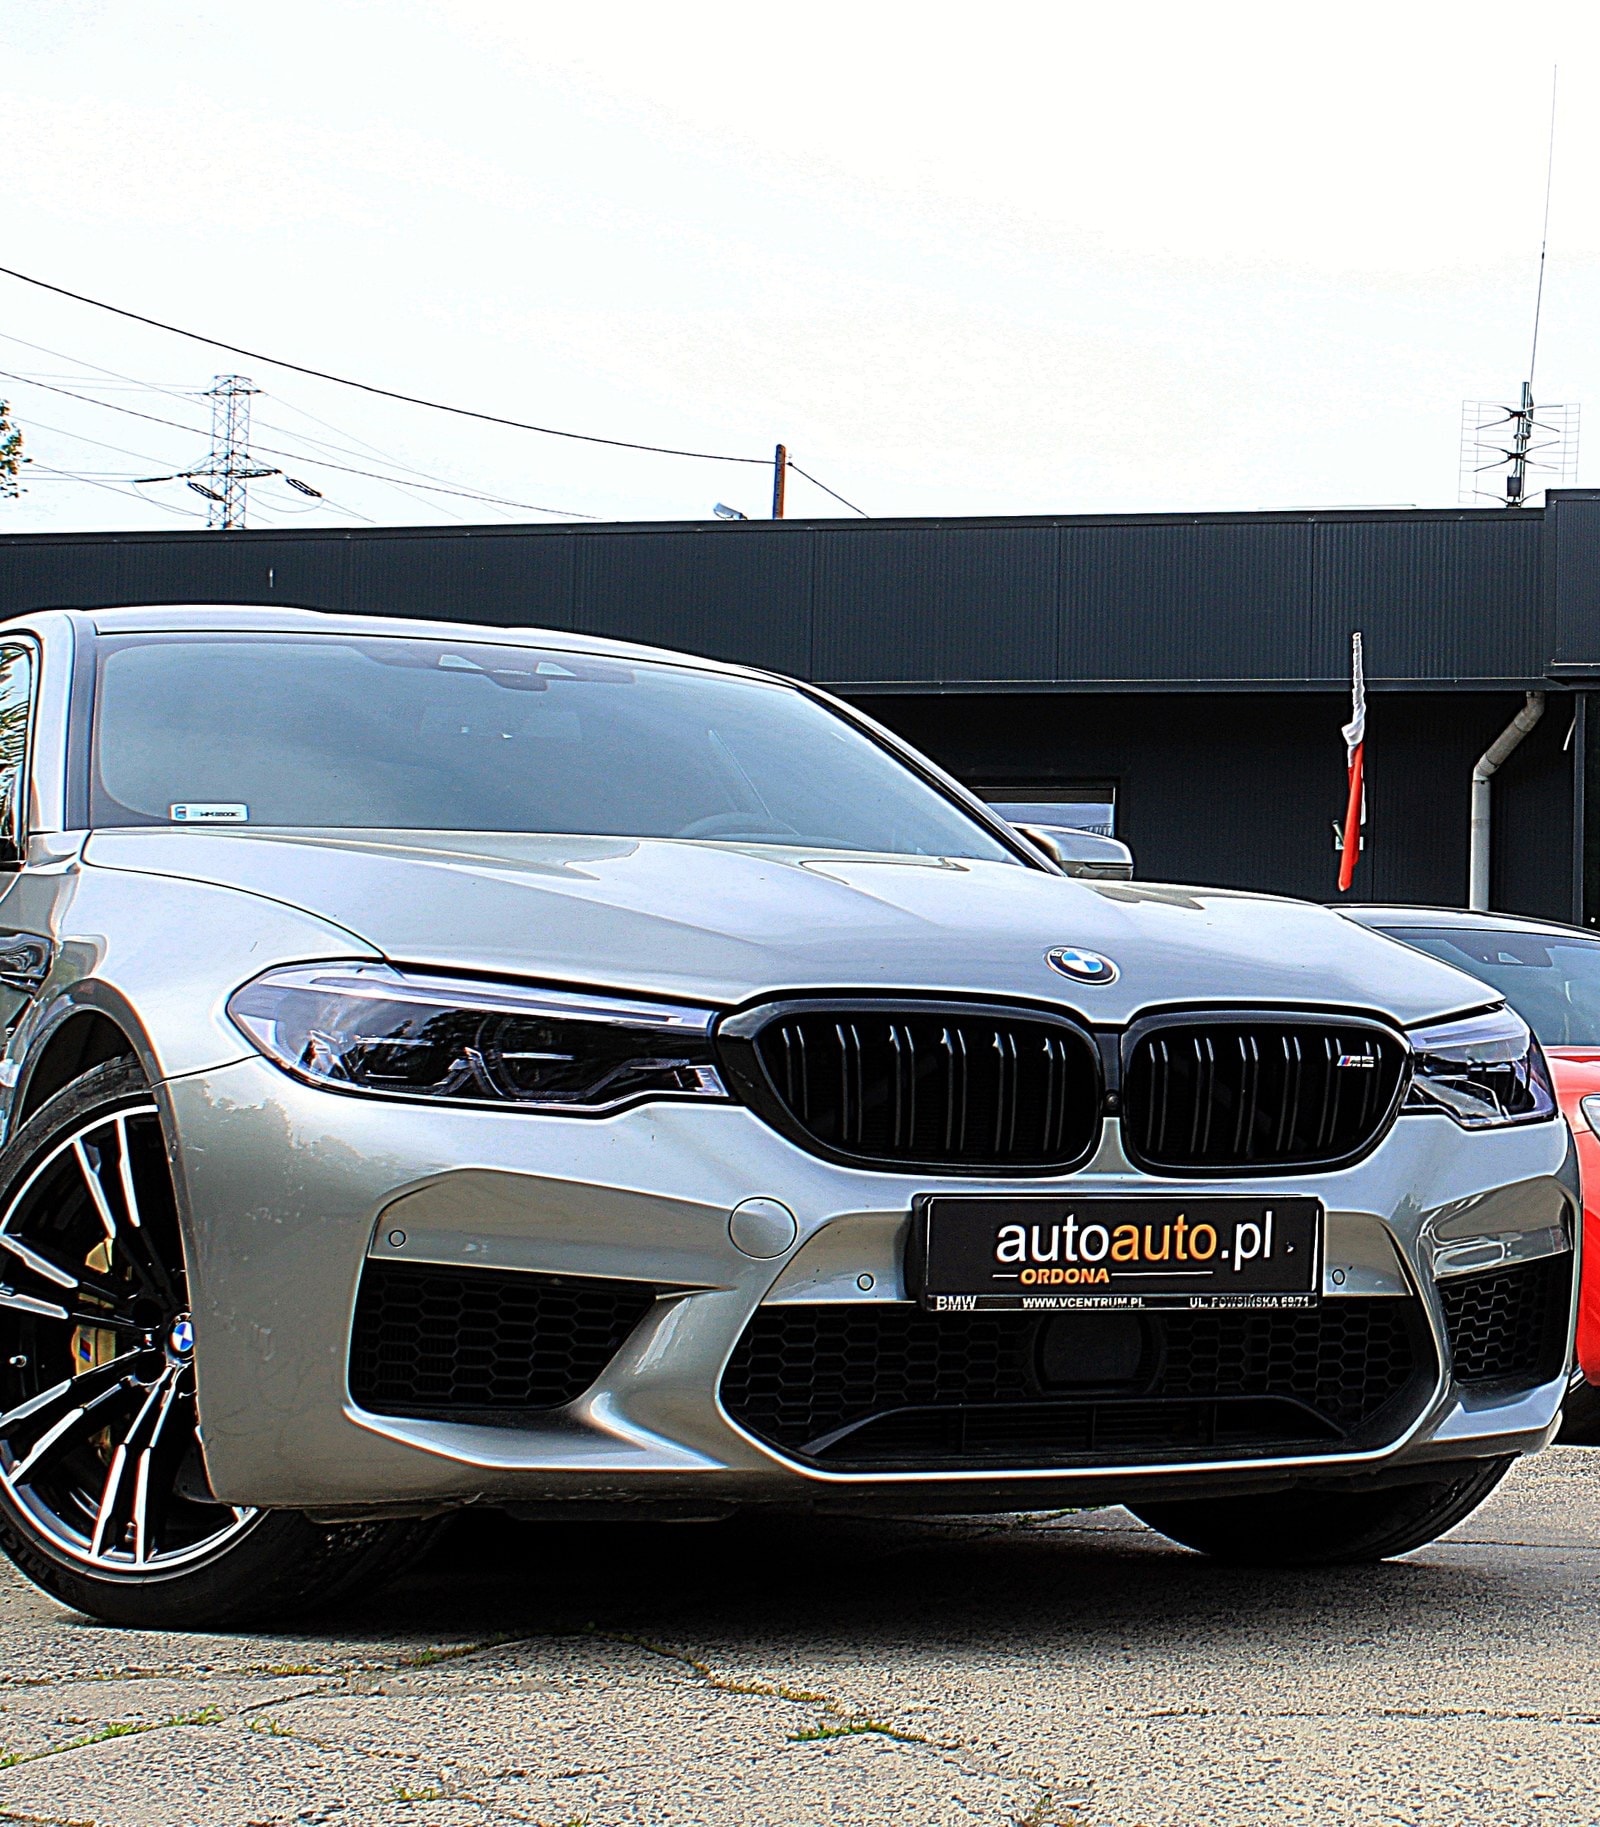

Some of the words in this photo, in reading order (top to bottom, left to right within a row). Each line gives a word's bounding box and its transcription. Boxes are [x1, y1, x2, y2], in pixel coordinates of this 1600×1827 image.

[996, 1210, 1273, 1271] autoauto.pl
[1019, 1267, 1110, 1285] ORDONA
[936, 1295, 977, 1311] BMW
[1022, 1297, 1145, 1309] WWW.VCENTRUM.PL
[1189, 1297, 1209, 1308] UL.
